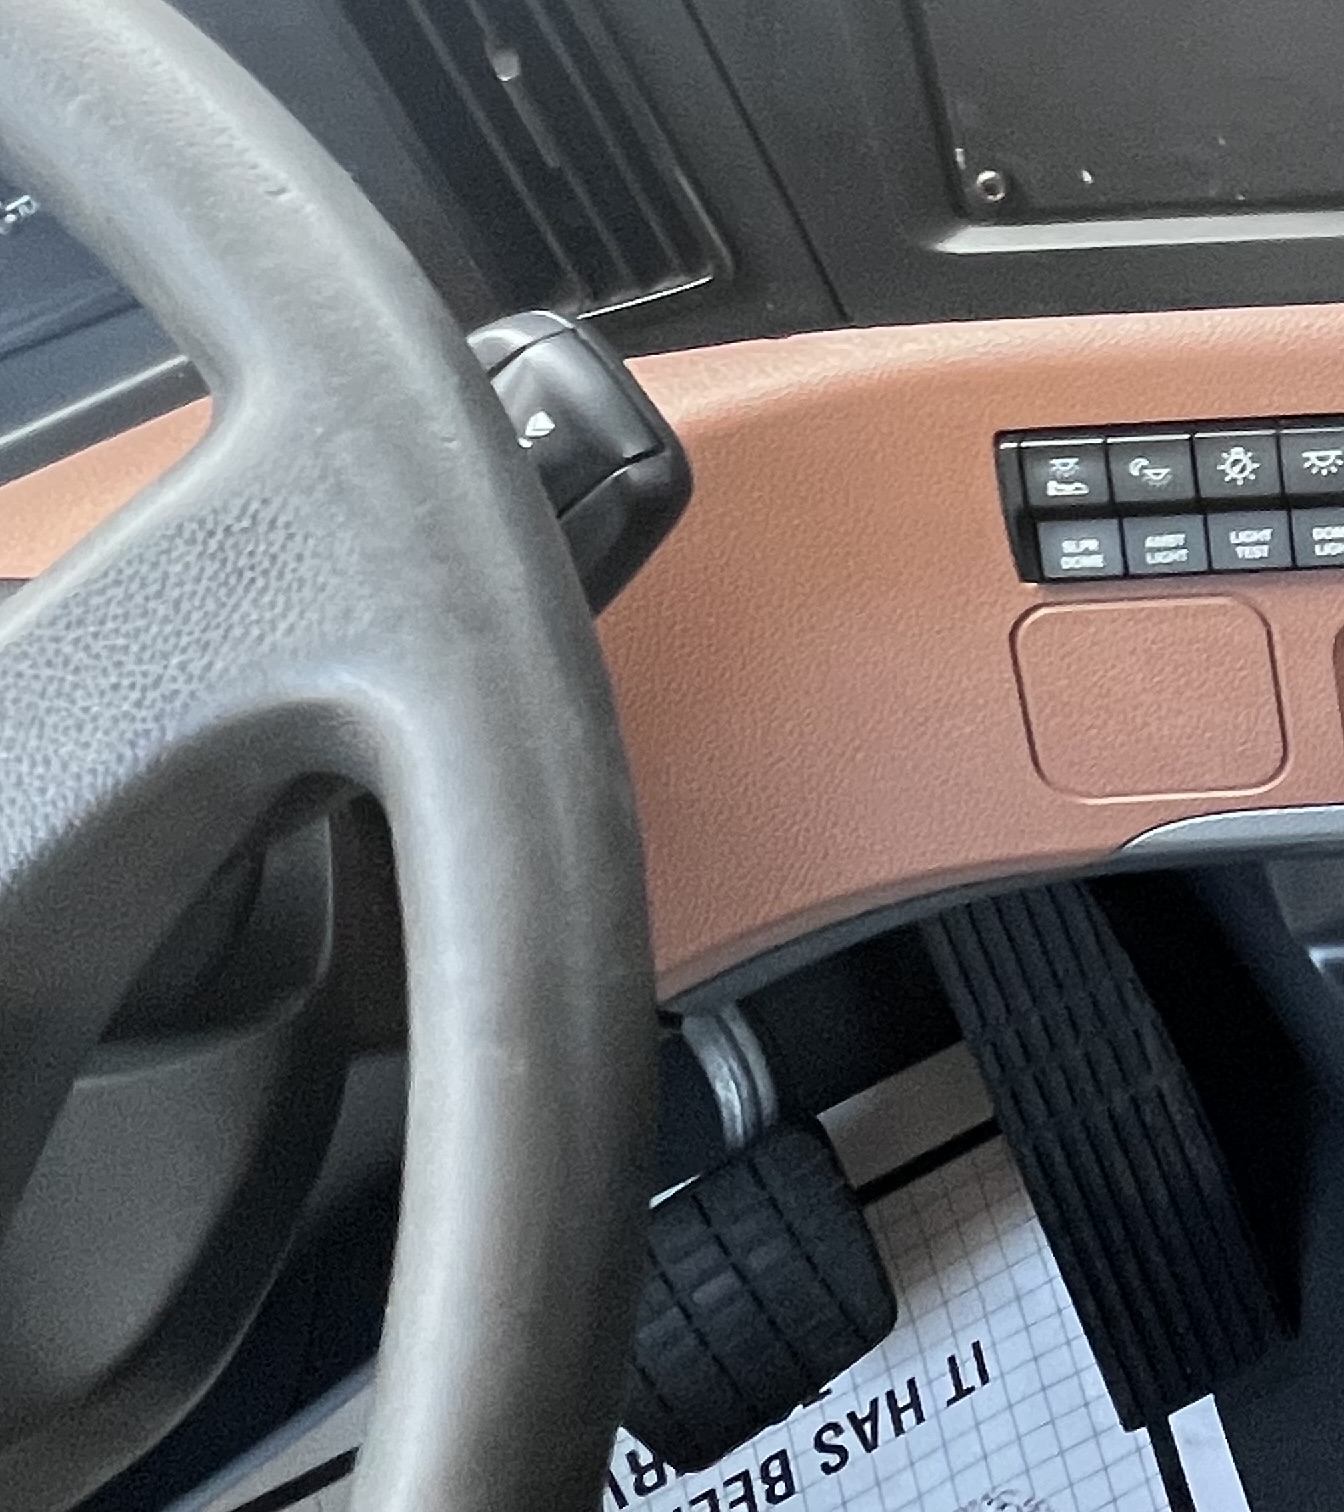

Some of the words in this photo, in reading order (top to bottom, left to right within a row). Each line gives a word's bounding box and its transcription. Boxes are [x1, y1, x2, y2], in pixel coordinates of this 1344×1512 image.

[1229, 528, 1273, 544] LIGHT
[946, 1339, 990, 1408] IT
[813, 1376, 926, 1476] HAS
